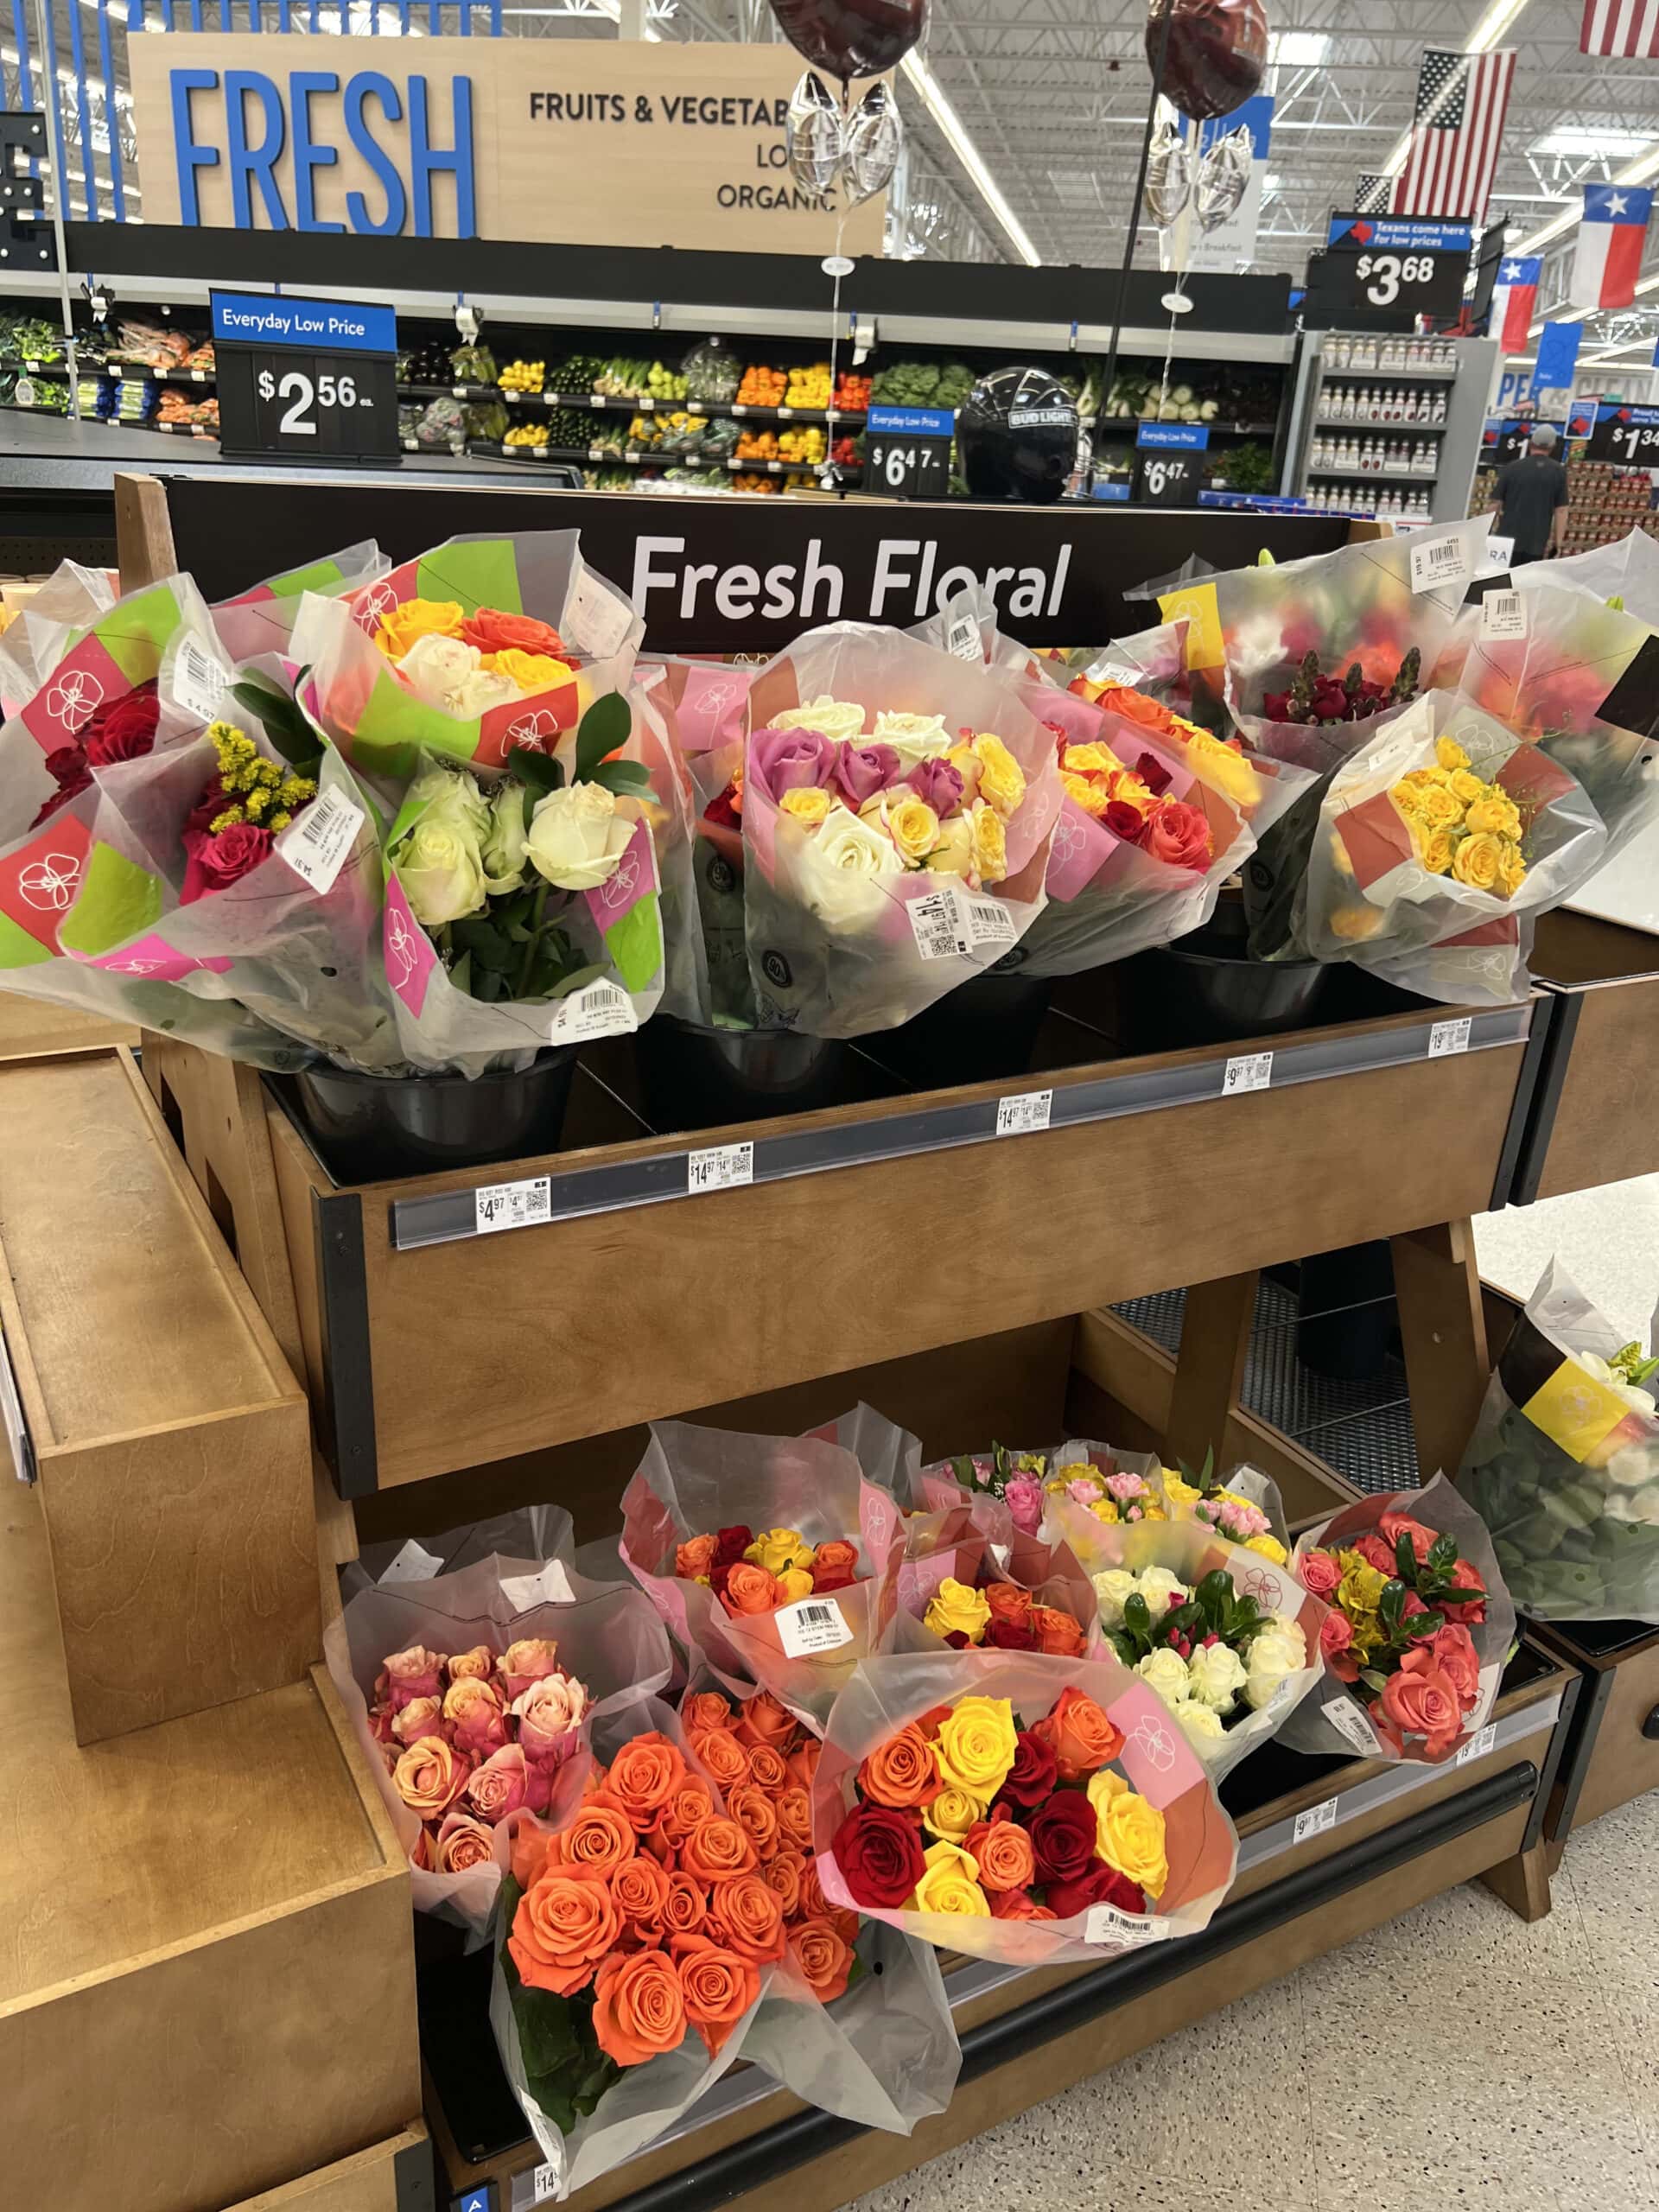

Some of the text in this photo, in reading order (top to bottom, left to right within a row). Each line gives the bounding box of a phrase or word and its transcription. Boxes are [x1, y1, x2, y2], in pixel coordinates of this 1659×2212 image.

[530, 92, 790, 126] FRUITS & VEGETAB
[170, 68, 476, 240] FRESH
[1376, 221, 1466, 236] Texans come here
[1374, 233, 1442, 248] for low prices
[222, 308, 366, 336] Everyday Low Price
[871, 413, 941, 429] Everyday Low Price
[1011, 410, 1072, 425] BUD LIGHT
[1141, 429, 1197, 444] Everyday Low Price
[632, 535, 1072, 620] Fresh Floral
